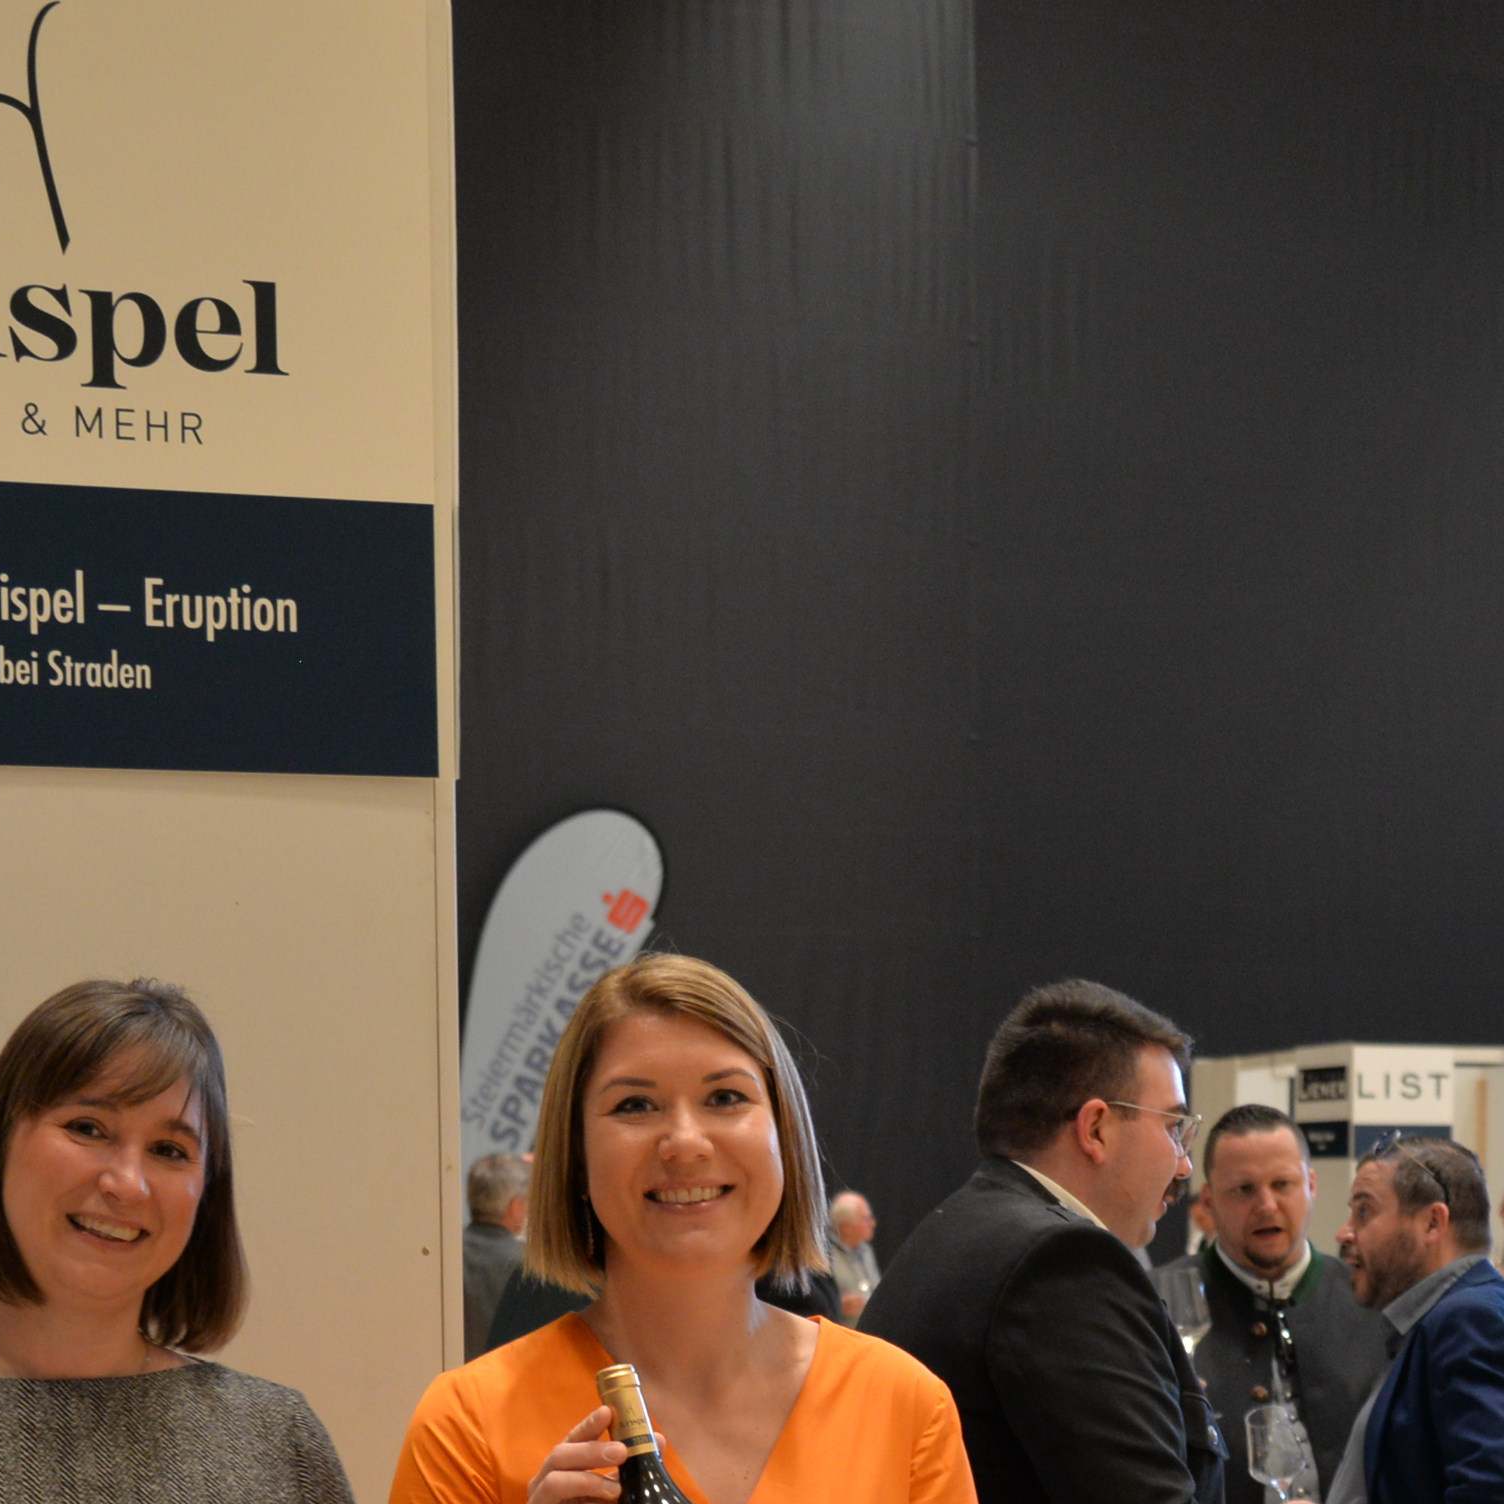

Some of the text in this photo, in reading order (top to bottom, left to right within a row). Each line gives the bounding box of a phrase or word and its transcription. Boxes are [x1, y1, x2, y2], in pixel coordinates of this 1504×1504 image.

[21, 402, 48, 436] &
[75, 406, 205, 445] MEHR
[144, 577, 299, 641] Eruption
[47, 650, 152, 690] Straden
[460, 911, 593, 1129] Steiermärkische
[488, 928, 626, 1149] SPARKASSE
[1357, 1073, 1448, 1099] LIST
